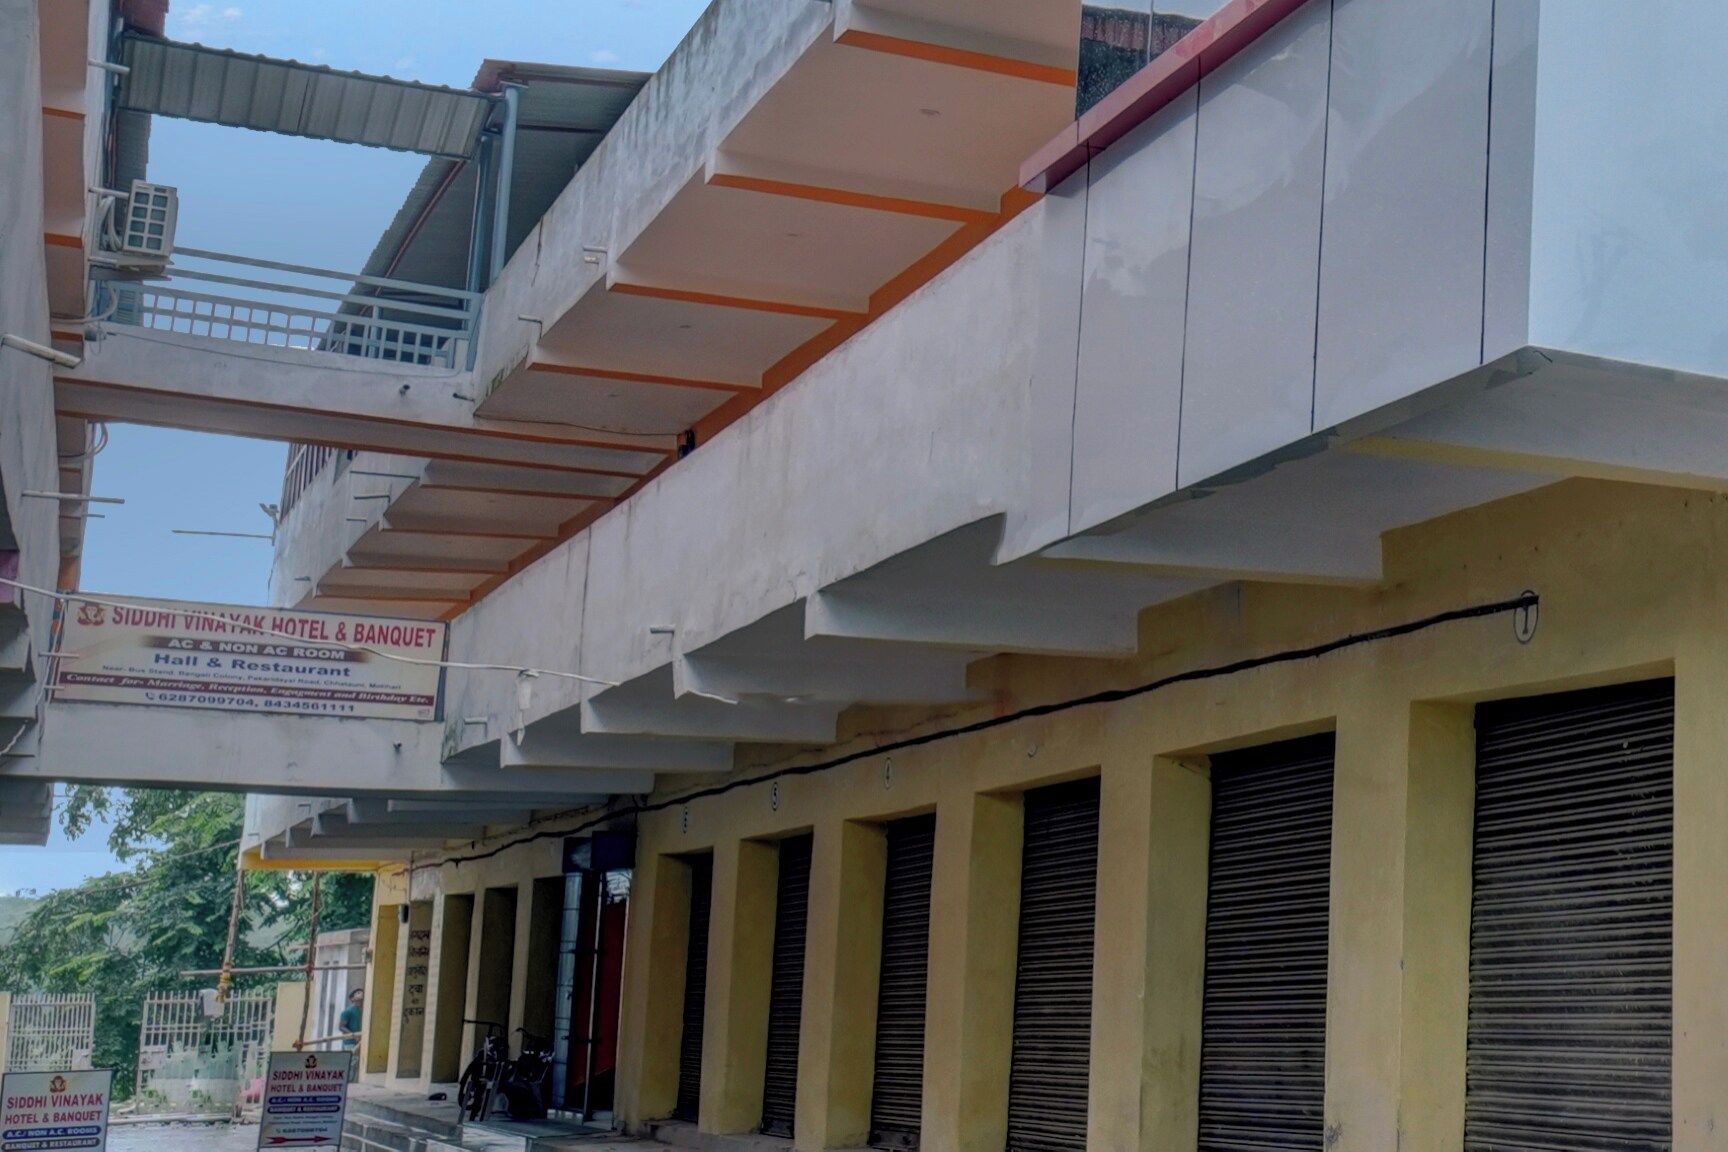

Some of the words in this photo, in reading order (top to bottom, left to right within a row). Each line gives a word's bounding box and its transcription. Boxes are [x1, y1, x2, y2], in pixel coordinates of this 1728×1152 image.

[112, 607, 177, 629] SIDDHI
[184, 609, 265, 636] VINAYAK
[272, 616, 329, 640] HOTEL
[335, 621, 347, 642] &
[353, 623, 436, 648] BANQUET
[168, 638, 194, 649] AC
[200, 641, 213, 651] &
[219, 642, 258, 654] NON
[264, 646, 288, 656] AC
[293, 647, 345, 660] ROOM
[154, 653, 198, 666] Hall
[207, 657, 222, 668] &
[231, 658, 351, 677] Restaurant
[67, 674, 115, 684] Contact
[147, 679, 205, 691] Marriage,
[209, 682, 267, 695] Reception,
[359, 692, 408, 704] Birthday
[272, 1070, 303, 1081] SIDDHI
[305, 1070, 345, 1080] VINAYAK
[270, 1084, 296, 1093] HOTEL
[306, 1083, 343, 1092] BANQUET
[7, 1095, 47, 1109] SIDDHI
[51, 1093, 104, 1107] VINAYAK
[4, 1113, 39, 1125] HOTEL
[42, 1113, 49, 1123] &
[53, 1110, 102, 1123] BANQUET
[28, 1129, 47, 1137] NON
[5, 1141, 40, 1150] BANQUET
[49, 1138, 97, 1147] RESTAURANT
